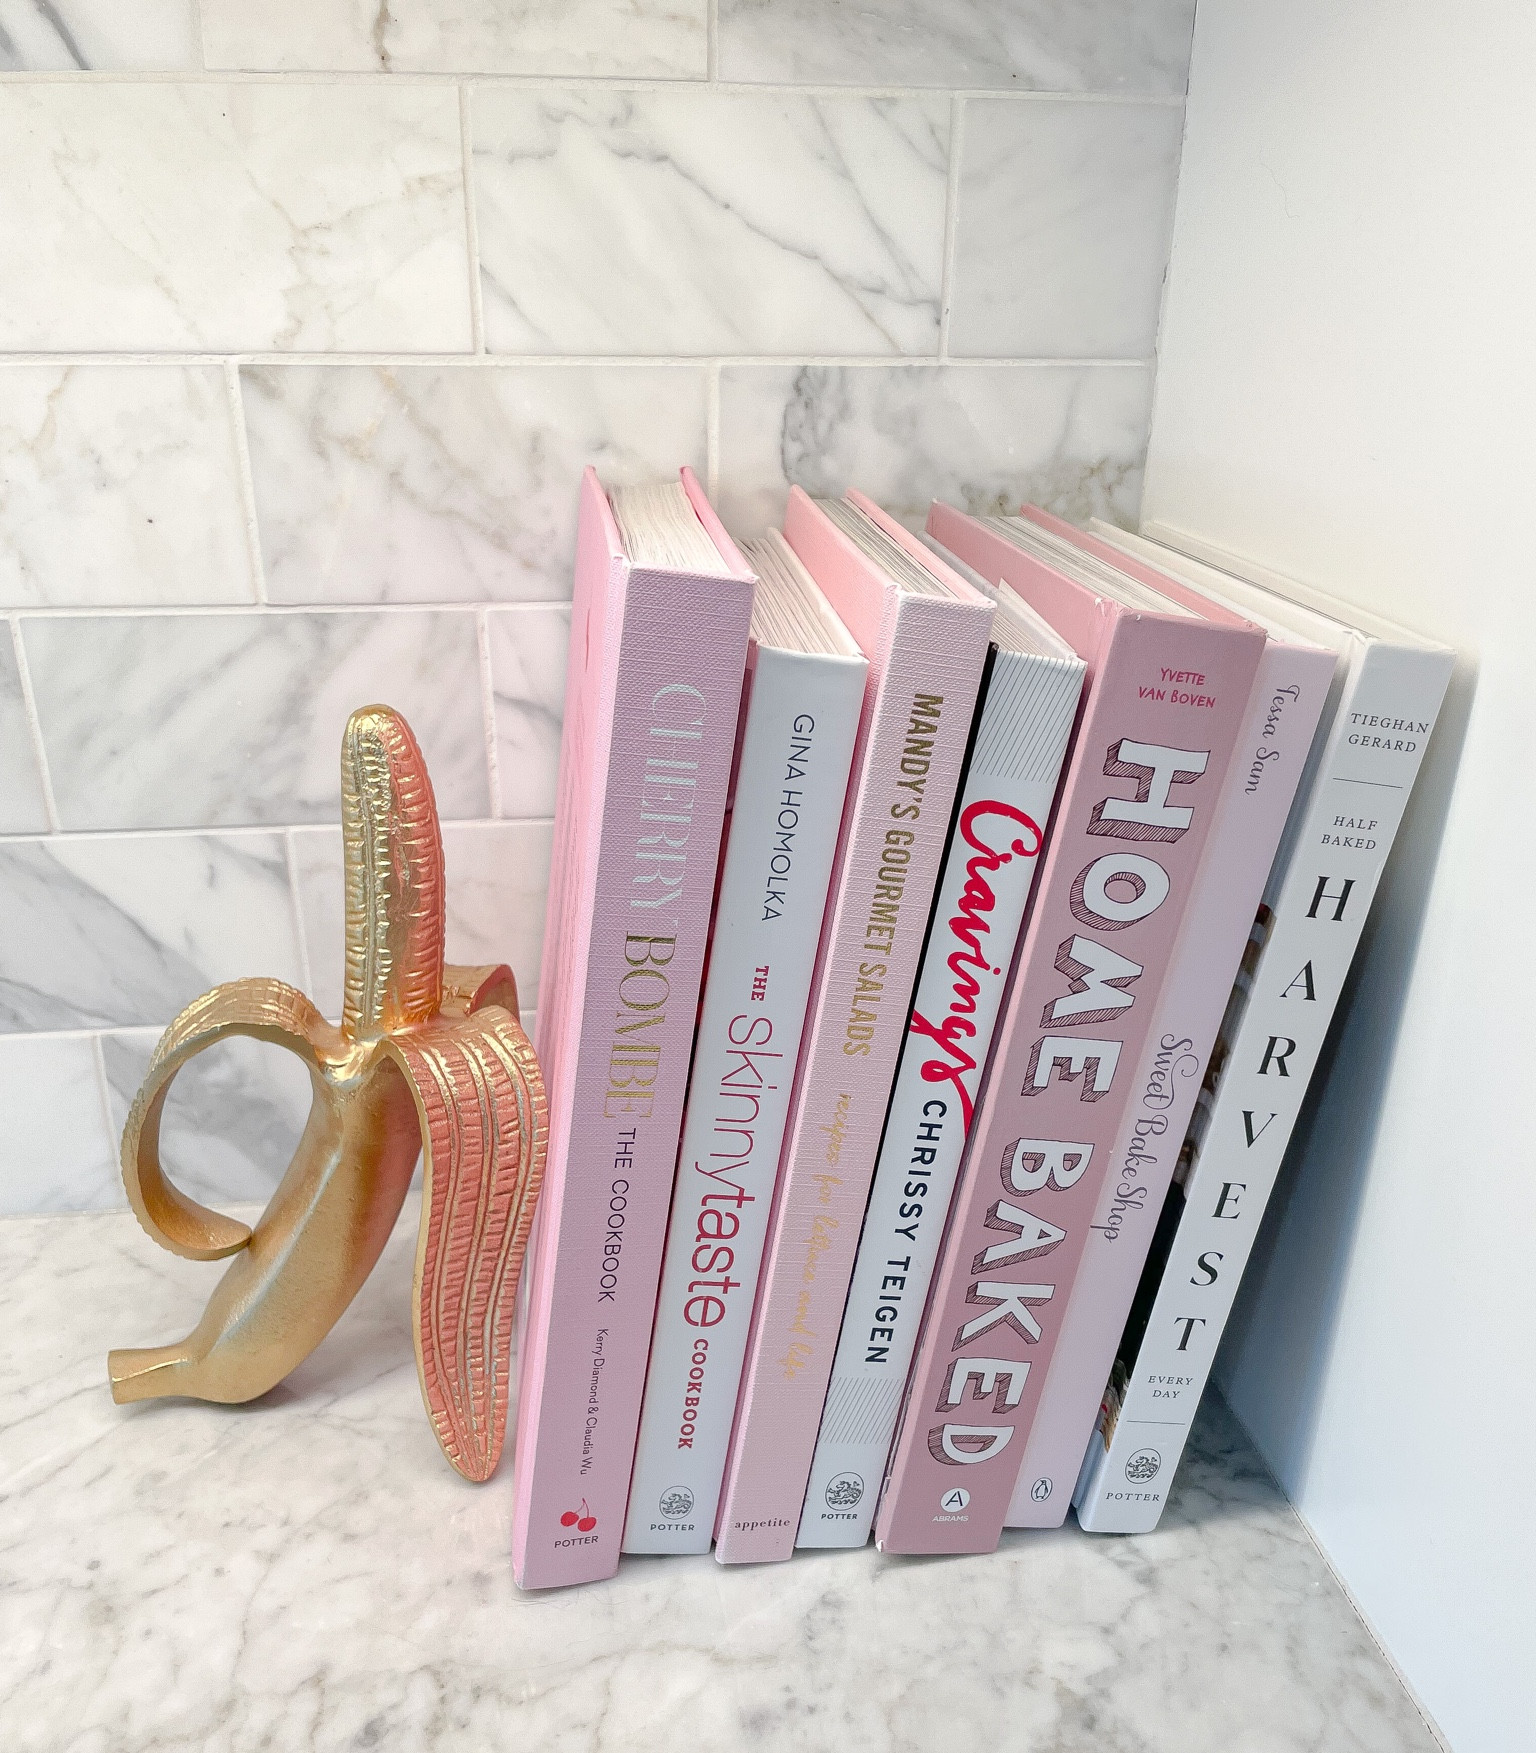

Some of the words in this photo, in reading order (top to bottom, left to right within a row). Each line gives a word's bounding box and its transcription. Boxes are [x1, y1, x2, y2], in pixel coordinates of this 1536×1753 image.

[1138, 686, 1166, 702] VAN
[1170, 690, 1216, 708] BOVEN
[1160, 667, 1206, 686] YVETTE
[1262, 684, 1301, 740] Tessa
[1351, 712, 1430, 734] TIEGHAN
[784, 714, 815, 782] GINA
[890, 693, 944, 821] MANDY'S
[1348, 734, 1417, 753] GERARD
[1244, 747, 1280, 795] Sam
[629, 683, 707, 926] CHERRY
[1333, 815, 1378, 831] HALF
[761, 790, 803, 922] HOMOLKA
[1320, 834, 1377, 851] BAKED
[863, 829, 915, 956] GOURMET
[1021, 737, 1211, 1103] HOME
[750, 965, 770, 1002] THE
[908, 799, 1043, 1142] Cravings
[604, 931, 677, 1118] BOMBE
[843, 962, 887, 1057] SALADS
[1142, 1033, 1199, 1110] Sweet
[1174, 875, 1356, 1353] HARVEST
[614, 1127, 637, 1169] THE
[1121, 1114, 1168, 1180] Bake
[811, 1173, 843, 1204] for
[894, 1100, 948, 1241] CHRISSY
[1089, 1182, 1147, 1243] Shop
[597, 1179, 630, 1303] COOKBOOK
[786, 1290, 816, 1337] and
[865, 1256, 911, 1364] TEIGEN
[927, 1137, 1095, 1466] BAKED
[592, 1328, 609, 1356] Kerry
[588, 1358, 606, 1404] Diamond
[677, 1339, 709, 1449] COOKBOOK
[1147, 1374, 1194, 1387] EVERY
[1152, 1388, 1180, 1399] DAY
[587, 1406, 599, 1414] &
[582, 1416, 598, 1455] Claudia
[580, 1456, 594, 1475] Wu
[821, 1513, 858, 1521] POTTER
[1105, 1491, 1162, 1502] POTTER
[554, 1535, 599, 1548] POTTER
[650, 1523, 695, 1532] POTTER
[734, 1517, 791, 1531] appetite
